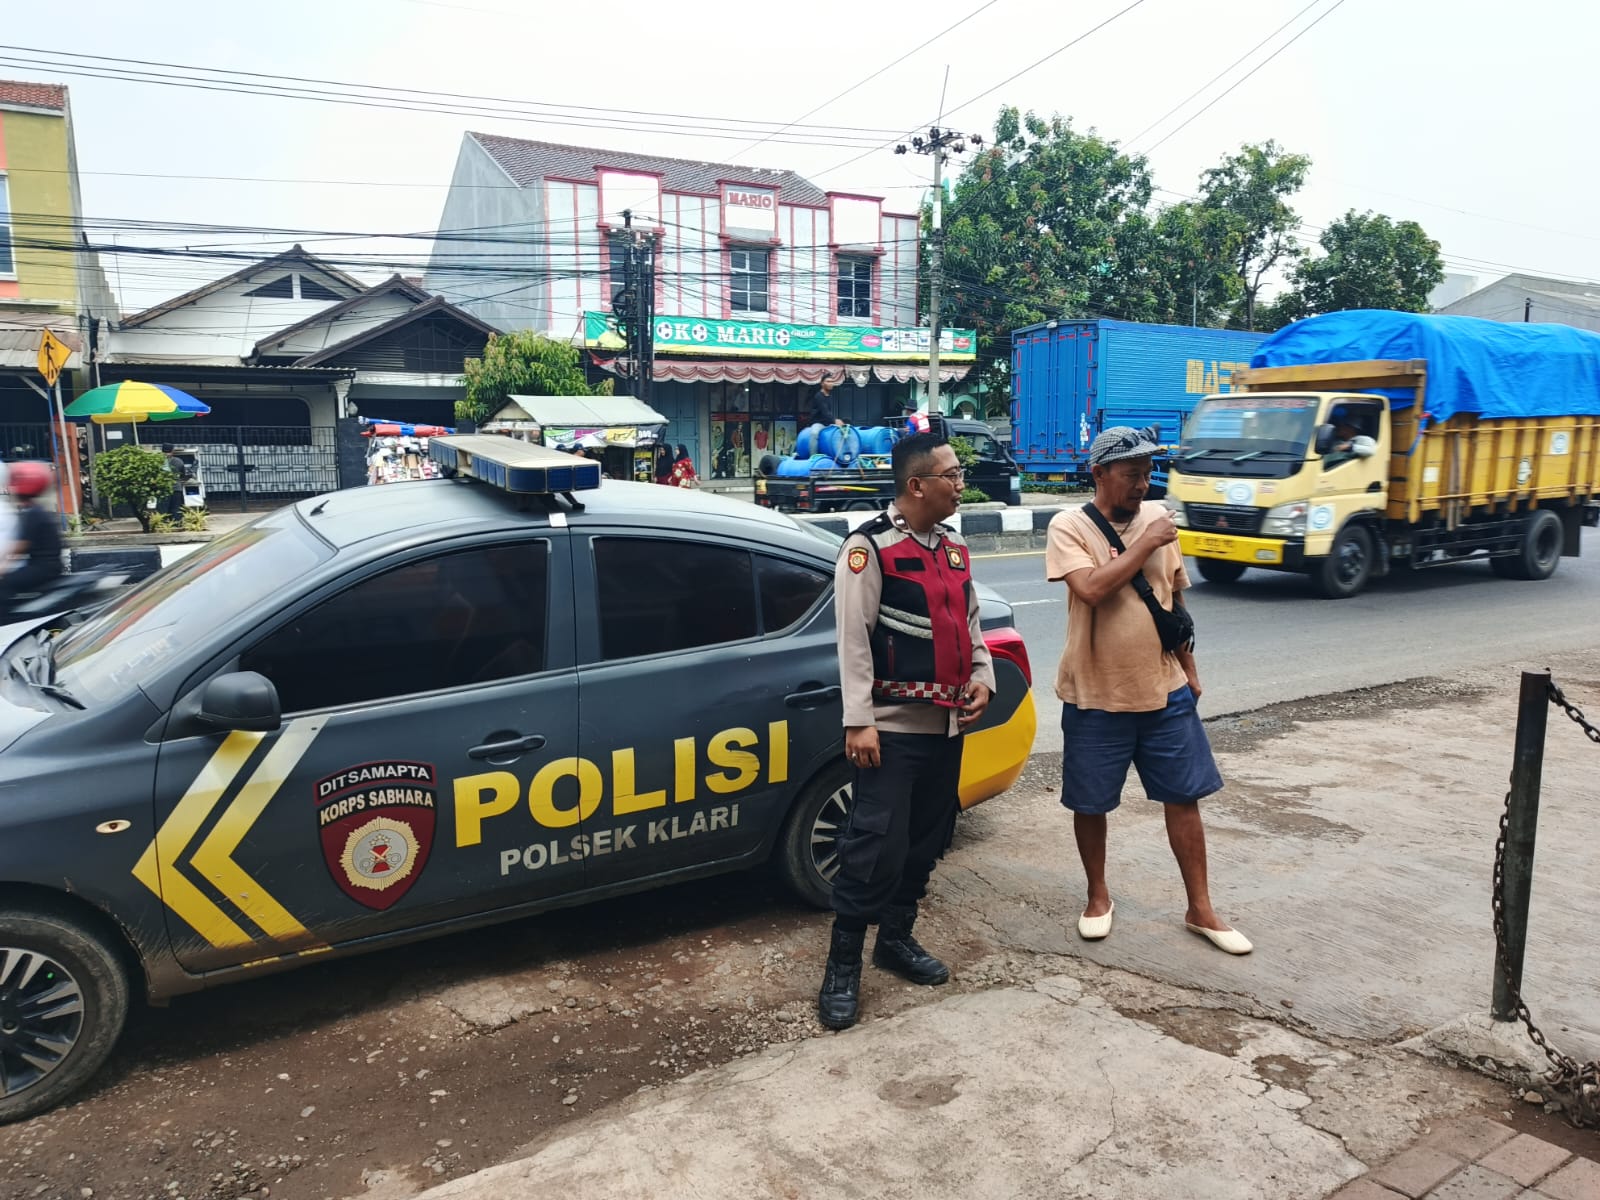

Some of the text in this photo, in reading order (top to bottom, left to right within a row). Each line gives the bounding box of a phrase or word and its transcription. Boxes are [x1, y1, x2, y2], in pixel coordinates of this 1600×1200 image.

[729, 192, 772, 208] MARIO
[655, 321, 708, 342] OKO
[717, 325, 791, 346] MARIO
[319, 765, 430, 797] DITSAMAPTA
[453, 719, 788, 848] POLISI
[320, 788, 434, 825] KORPS SABHARA
[500, 803, 739, 876] POLSEK KLARI
